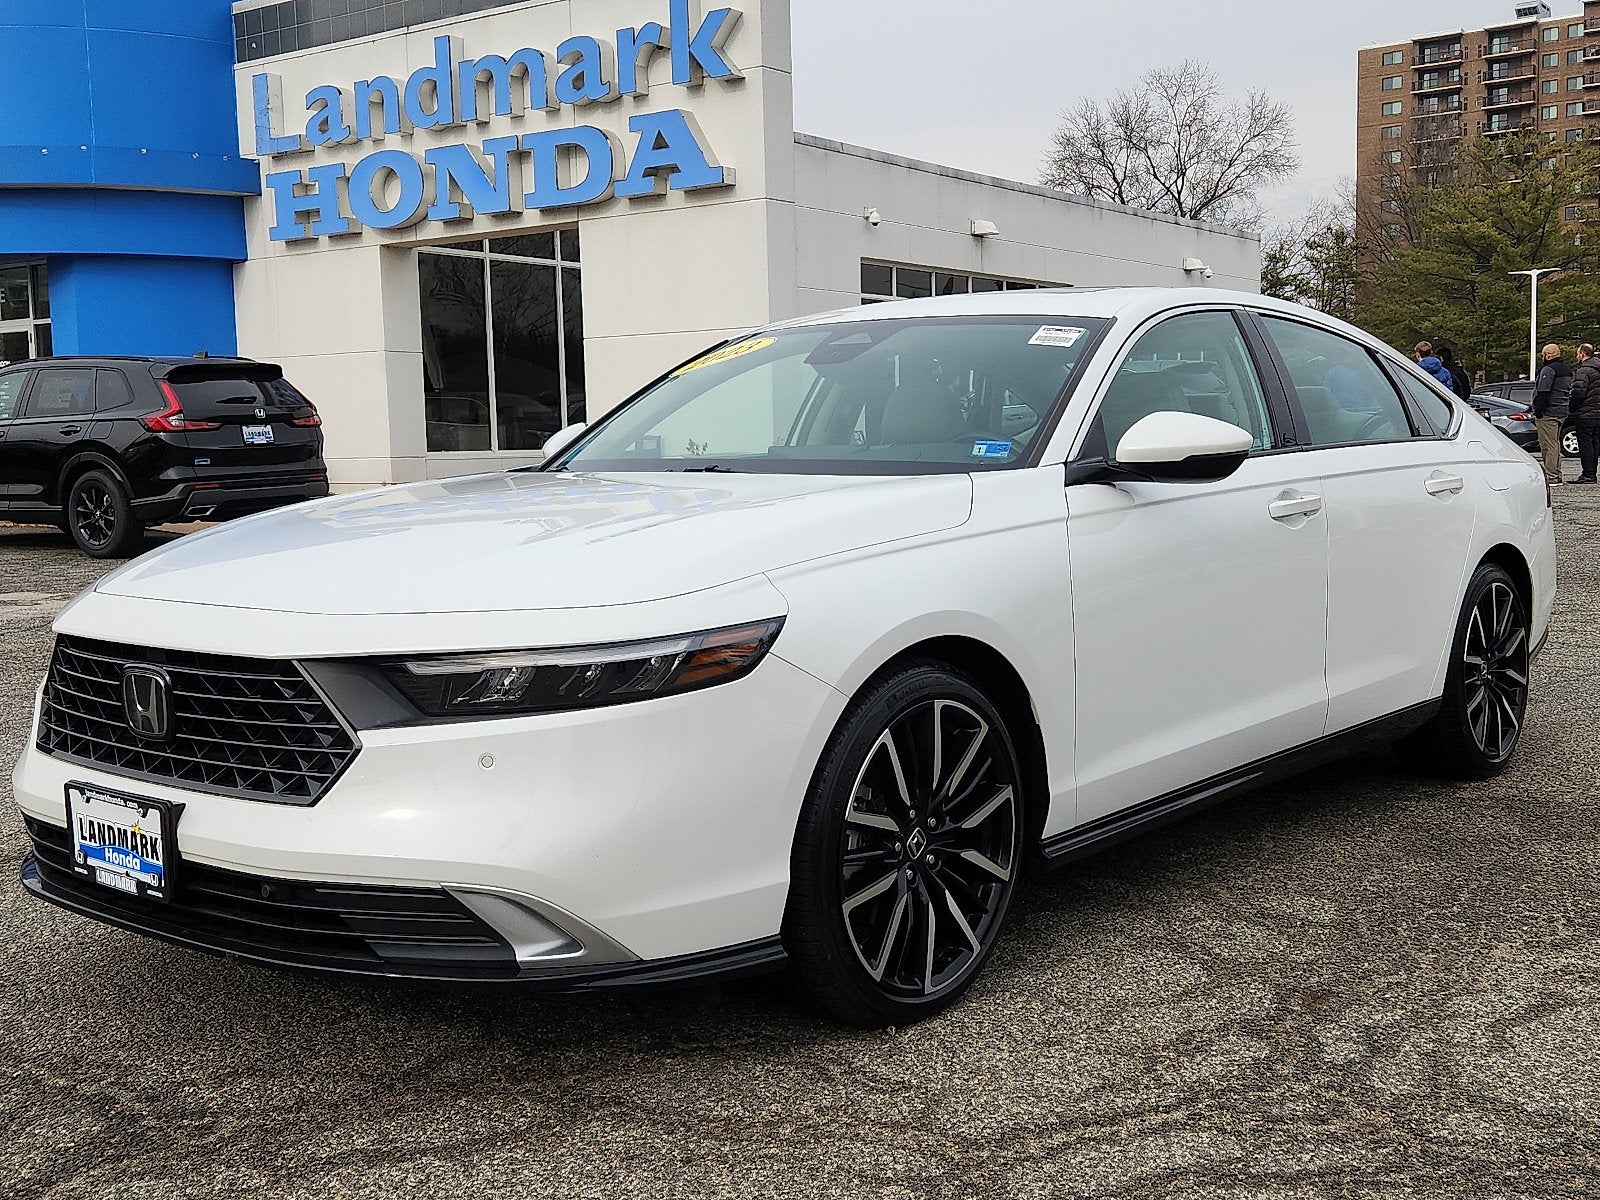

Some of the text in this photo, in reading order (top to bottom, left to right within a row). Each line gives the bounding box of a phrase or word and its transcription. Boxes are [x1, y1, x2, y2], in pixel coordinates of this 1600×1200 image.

[252, 0, 742, 157] Landmark
[266, 109, 734, 242] HONDA
[78, 816, 161, 862] LANDMARK
[105, 847, 140, 871] Honda
[96, 868, 138, 894] LANDMARK
